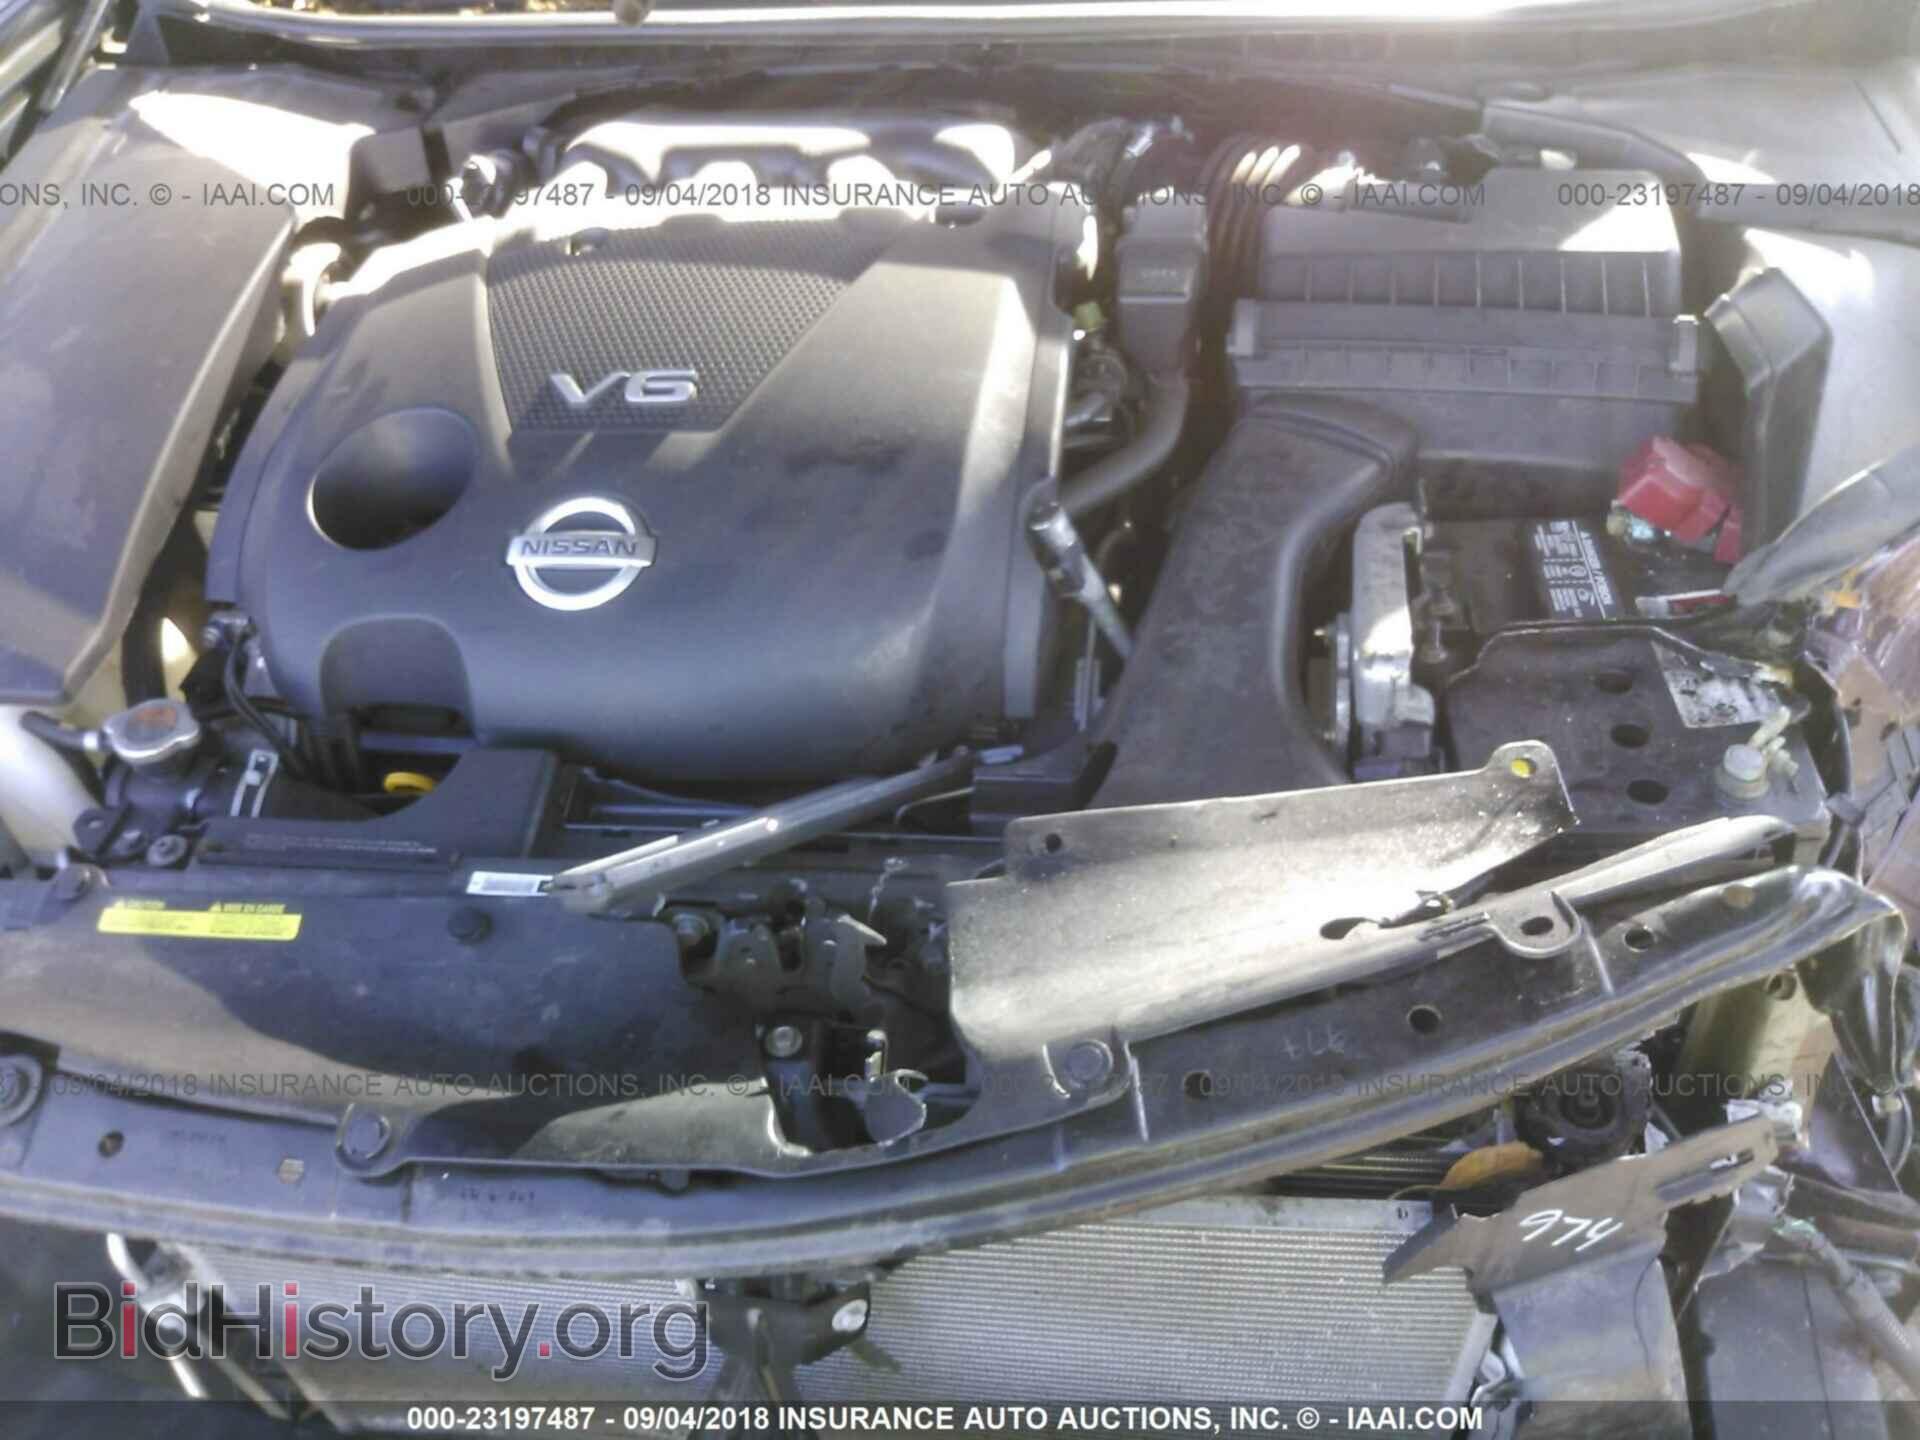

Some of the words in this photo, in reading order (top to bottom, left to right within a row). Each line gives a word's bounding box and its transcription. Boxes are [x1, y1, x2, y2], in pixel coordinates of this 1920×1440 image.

[551, 369, 698, 404] V6
[522, 538, 637, 556] NISSAN
[1520, 1208, 1623, 1251] 974
